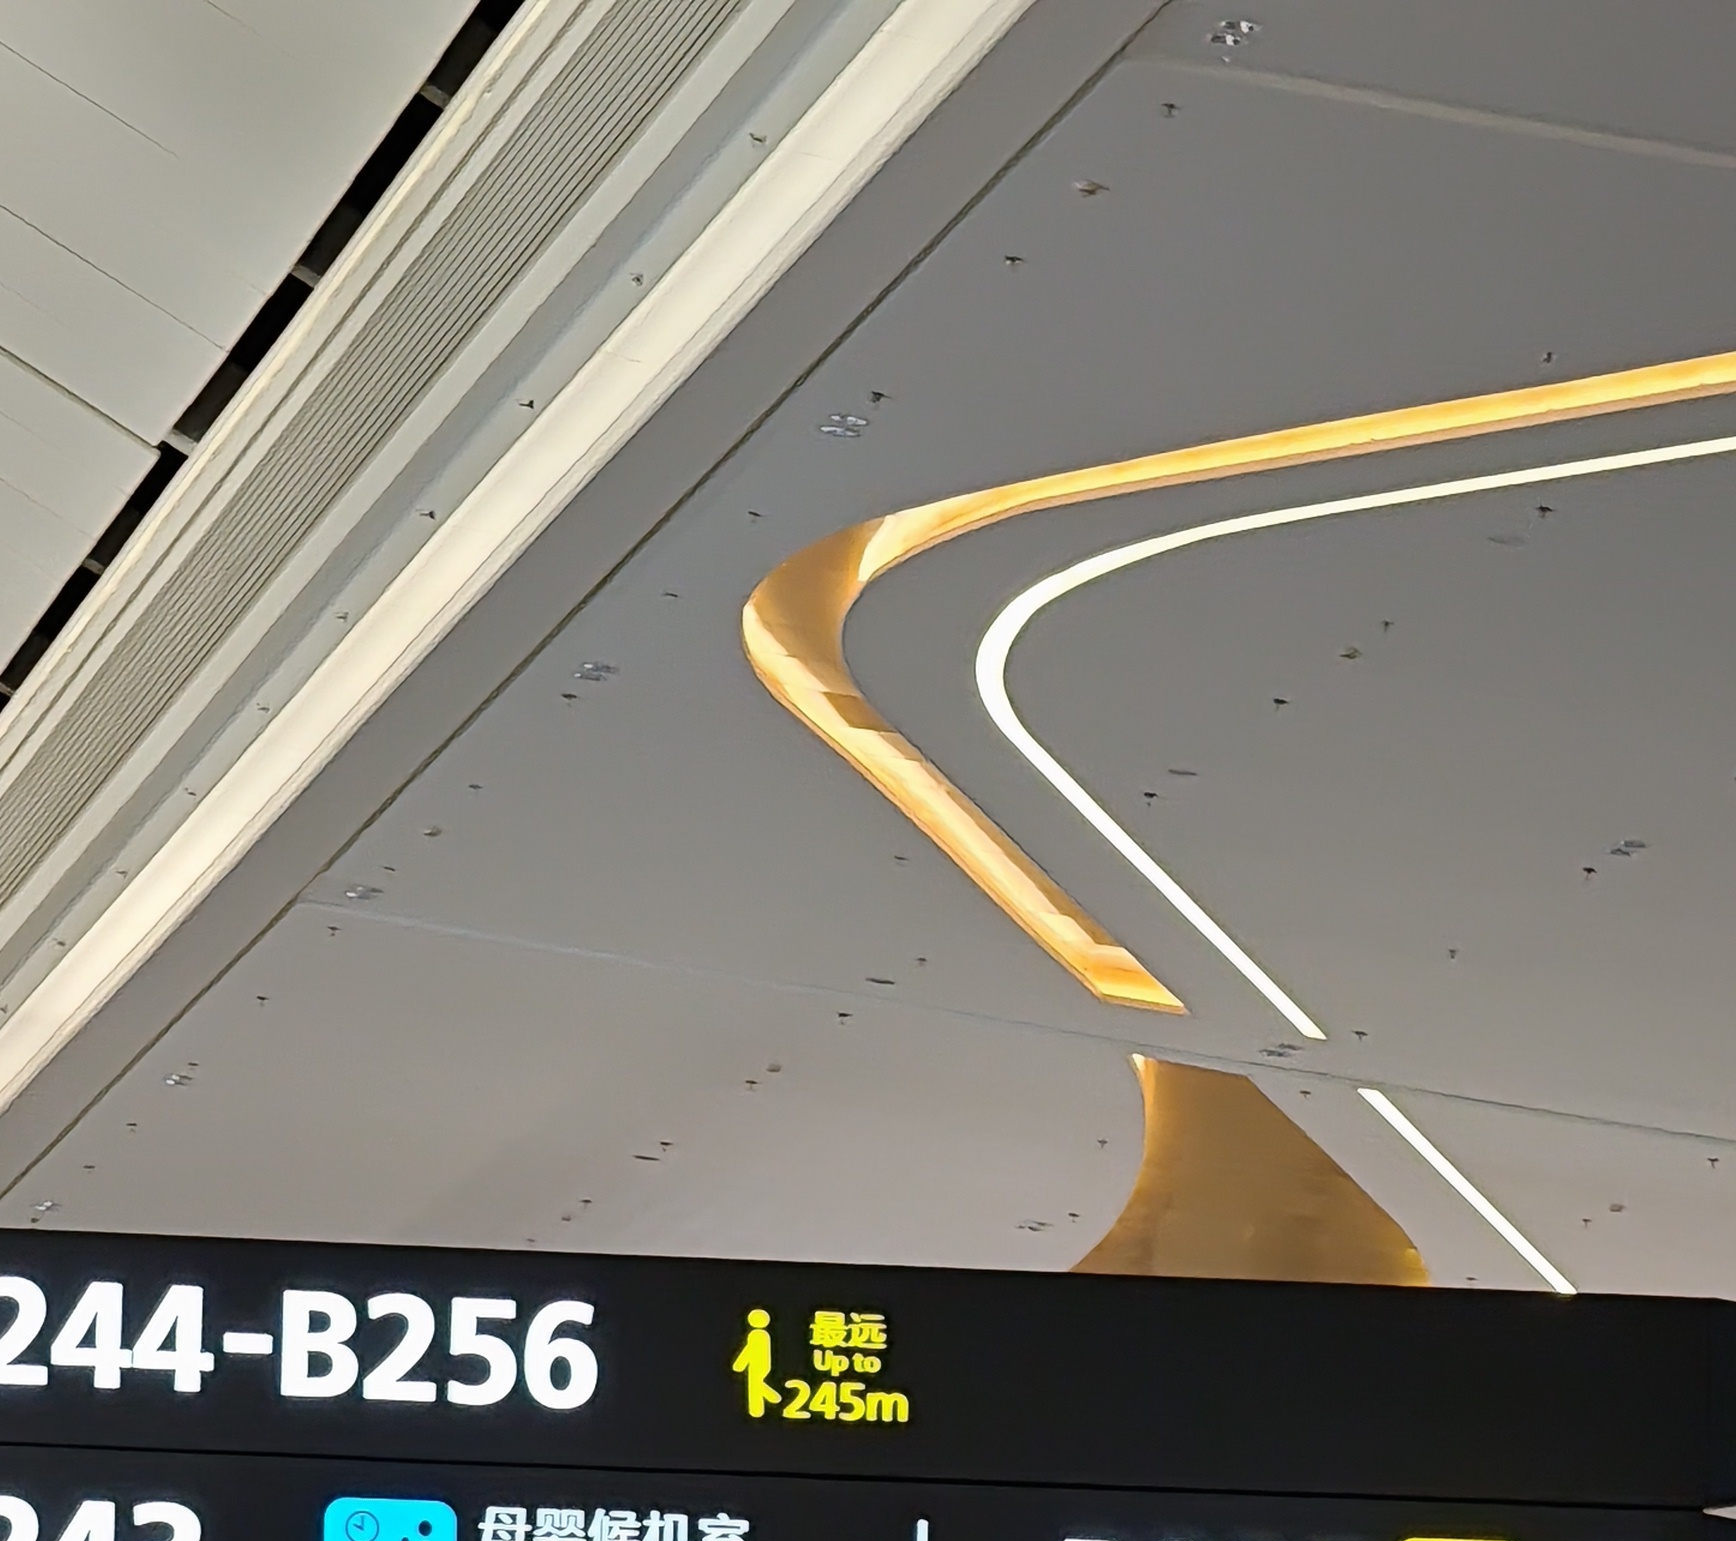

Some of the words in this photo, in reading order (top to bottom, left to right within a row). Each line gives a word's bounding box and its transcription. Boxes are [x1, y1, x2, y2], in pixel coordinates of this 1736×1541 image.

[809, 1311, 887, 1349] 最远
[814, 1350, 849, 1376] Up
[852, 1353, 881, 1373] to
[782, 1379, 909, 1423] 245m
